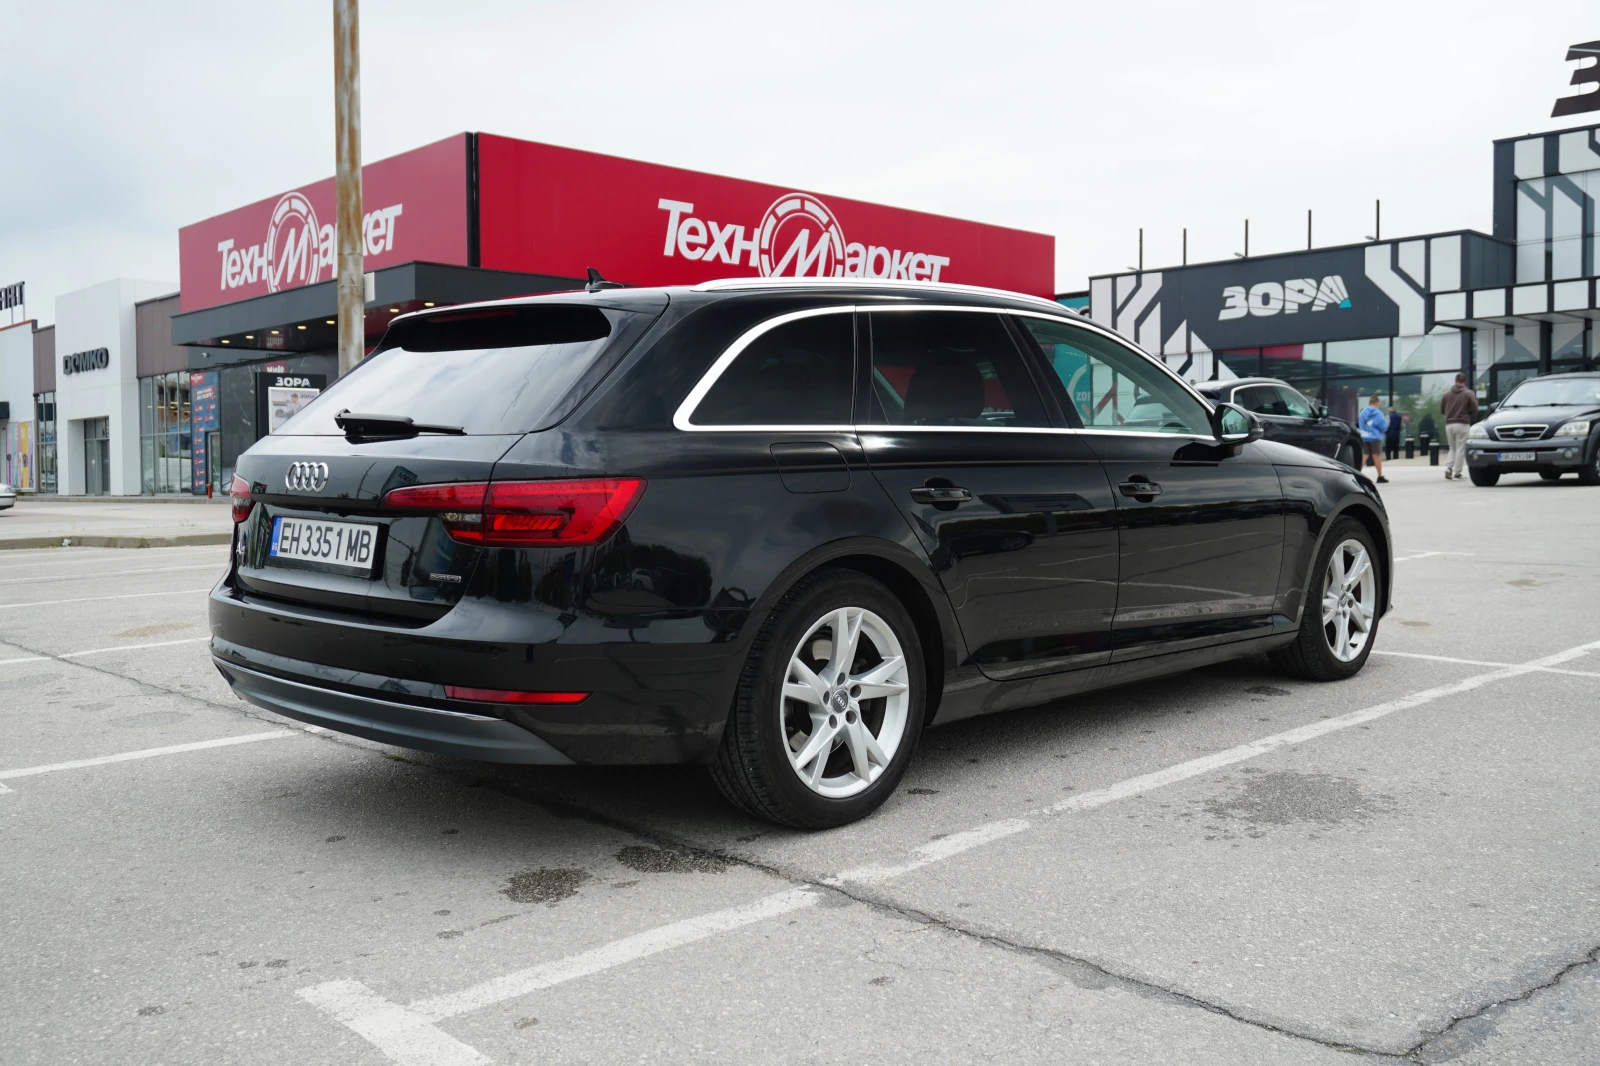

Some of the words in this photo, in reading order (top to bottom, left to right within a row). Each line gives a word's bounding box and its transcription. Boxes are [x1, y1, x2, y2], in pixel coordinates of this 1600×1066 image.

[1218, 275, 1352, 320] ЗОРА
[63, 347, 109, 375] DOMKO
[275, 376, 311, 388] ЗОРА
